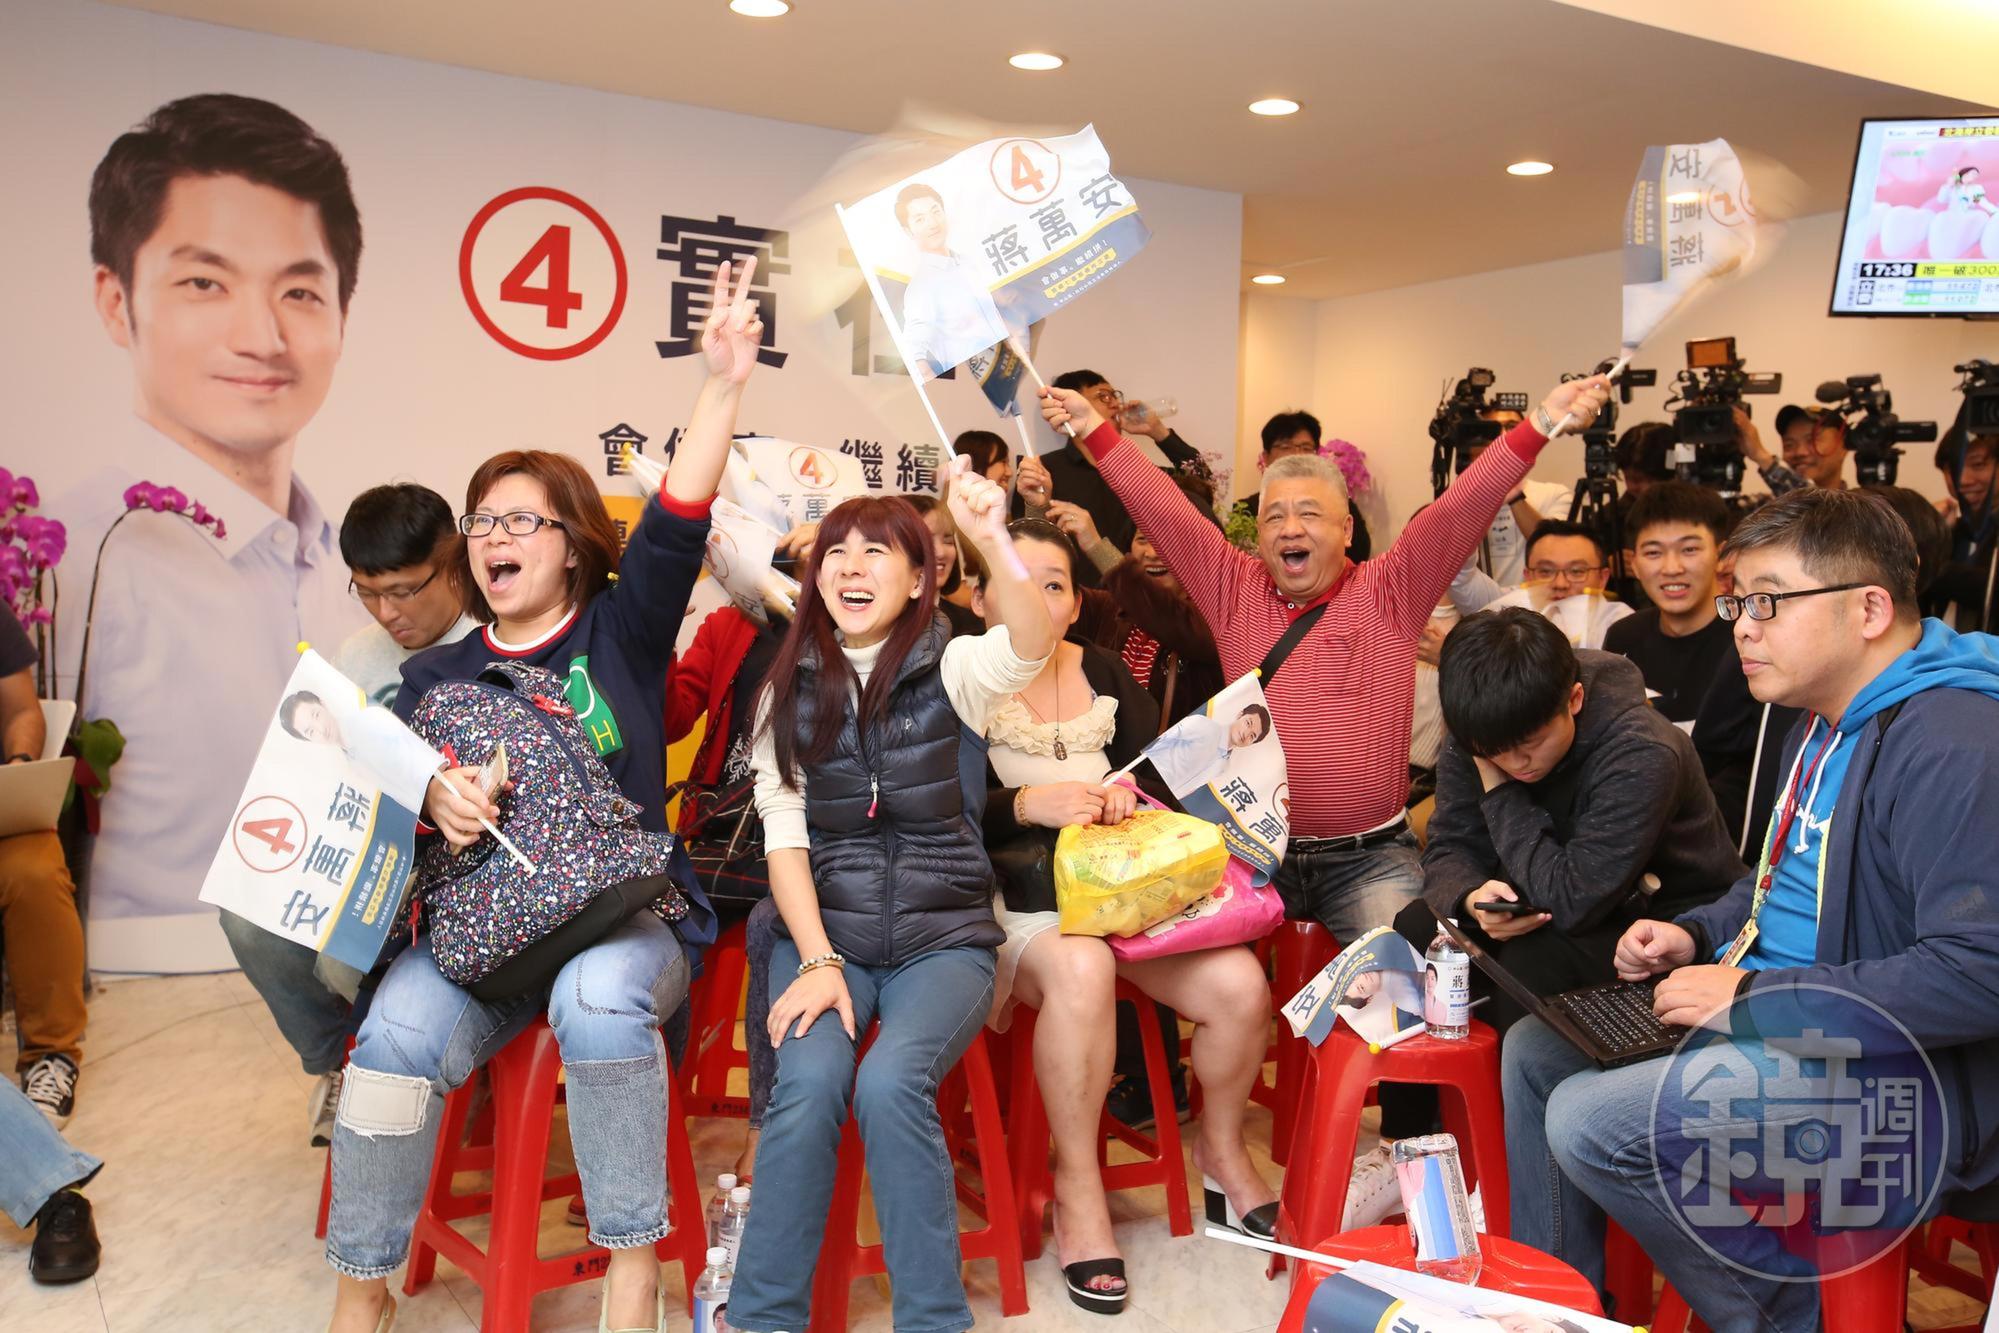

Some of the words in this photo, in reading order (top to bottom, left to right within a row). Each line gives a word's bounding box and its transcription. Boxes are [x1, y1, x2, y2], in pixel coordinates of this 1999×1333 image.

[1011, 146, 1045, 194] 4
[982, 173, 1123, 277] 蔣萬安
[499, 224, 583, 329] 4
[1862, 263, 1914, 278] 17:36
[799, 453, 822, 485] 4
[591, 719, 616, 752] H
[241, 816, 296, 857] 4
[280, 781, 373, 936] 蔣萬安
